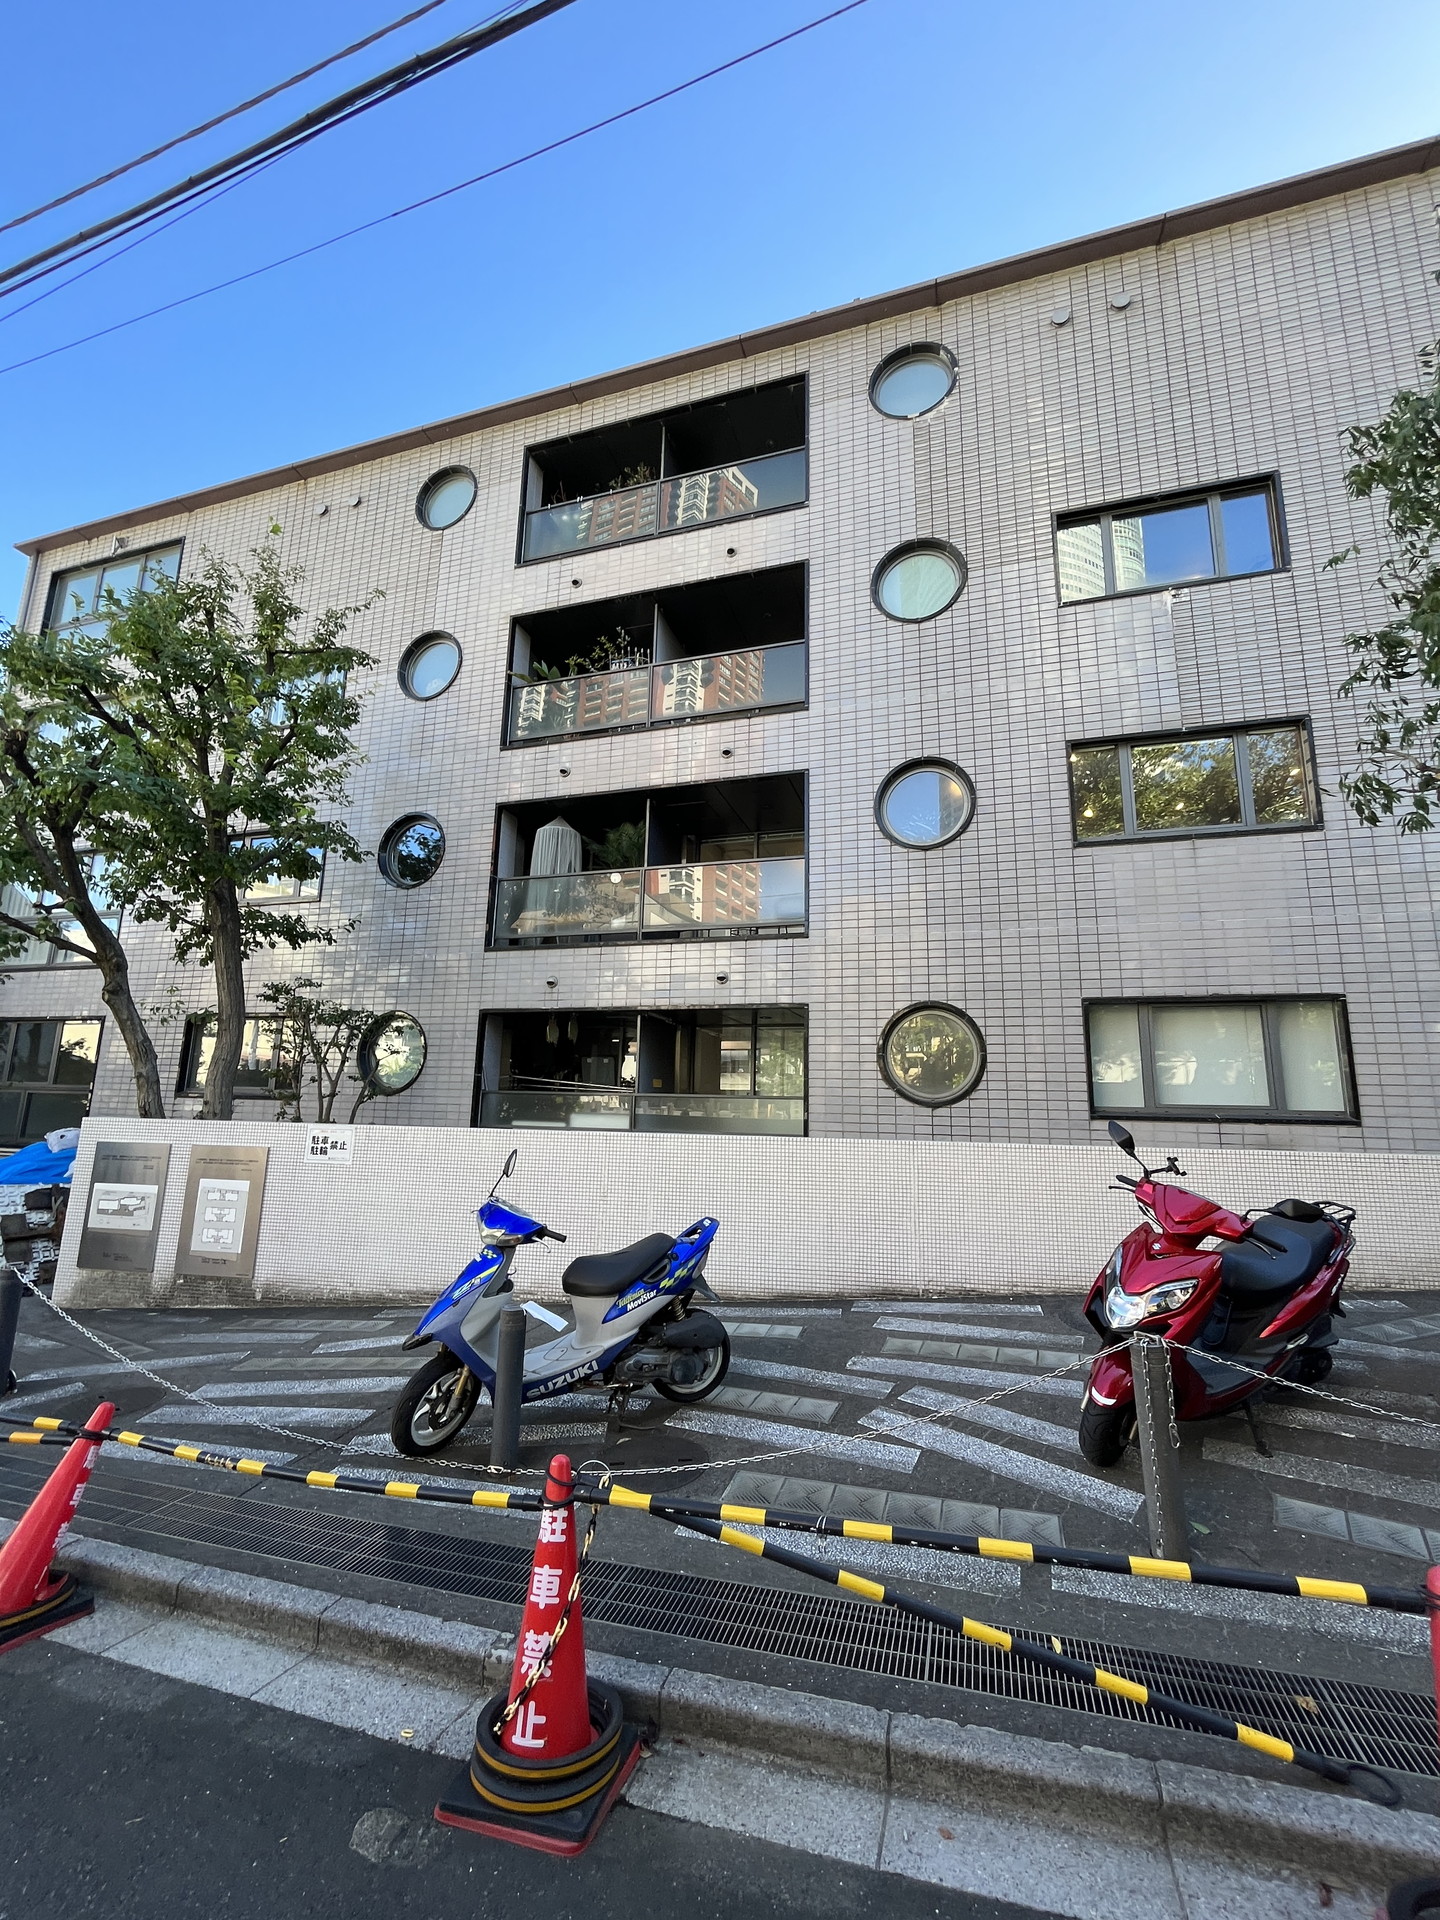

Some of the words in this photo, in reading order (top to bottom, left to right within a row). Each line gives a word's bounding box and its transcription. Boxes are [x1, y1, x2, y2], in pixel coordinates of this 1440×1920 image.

[311, 1135, 330, 1145] 駐車
[329, 1140, 348, 1151] 禁止
[310, 1145, 329, 1156] 駐輪
[627, 1289, 657, 1312] MoviStar
[526, 1359, 599, 1399] SUZUKI
[511, 1505, 568, 1748] 駐車禁止
